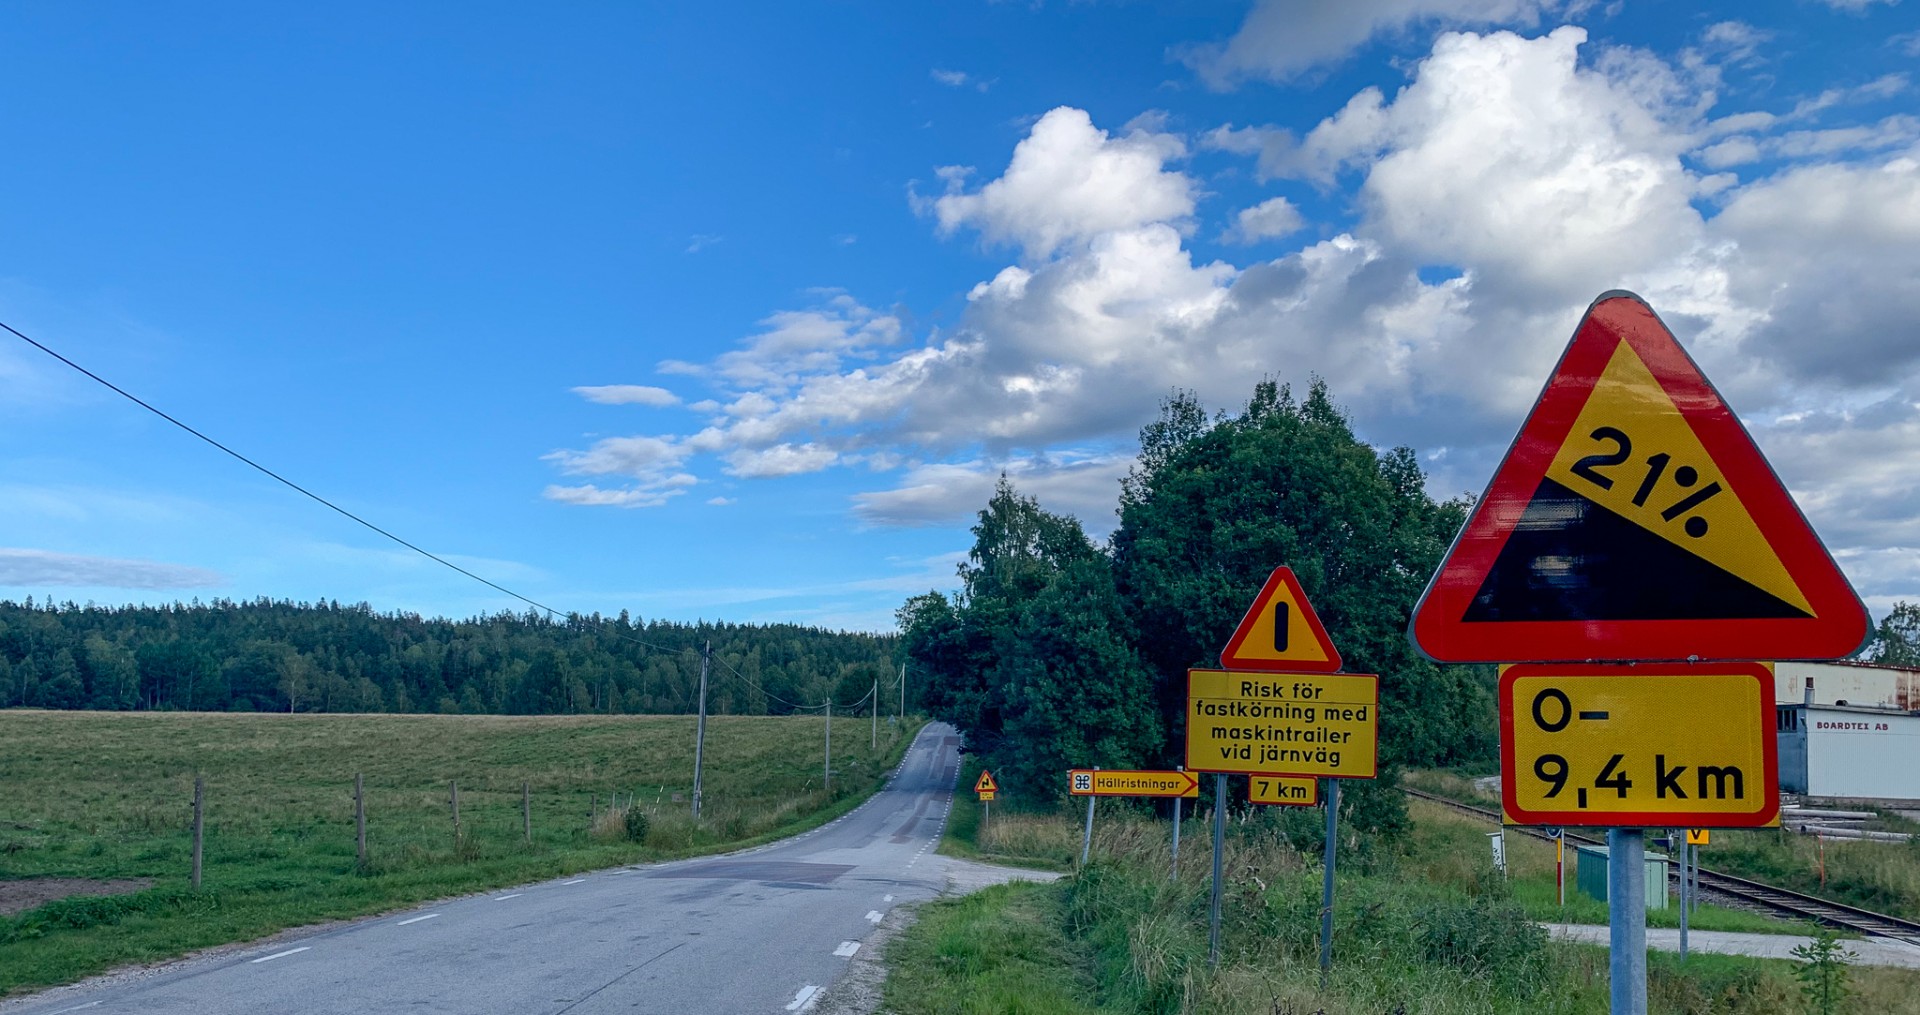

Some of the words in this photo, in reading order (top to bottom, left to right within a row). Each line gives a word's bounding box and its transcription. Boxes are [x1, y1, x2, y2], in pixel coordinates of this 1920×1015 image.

[1570, 426, 1722, 538] 21%
[1241, 681, 1284, 698] Risk
[1293, 683, 1323, 699] för
[1196, 700, 1316, 723] fastkörning
[1324, 706, 1367, 722] med
[1211, 725, 1352, 744] maskintrailer
[1816, 721, 1869, 731] BOARDTEX
[1874, 723, 1889, 731] AB
[1220, 744, 1251, 760] vid
[1259, 745, 1340, 767] järnväg
[1097, 778, 1181, 791] Hällristningar
[1257, 781, 1269, 797] 7
[1278, 782, 1307, 798] km
[1533, 754, 1632, 809] 9,4
[1655, 754, 1744, 800] km
